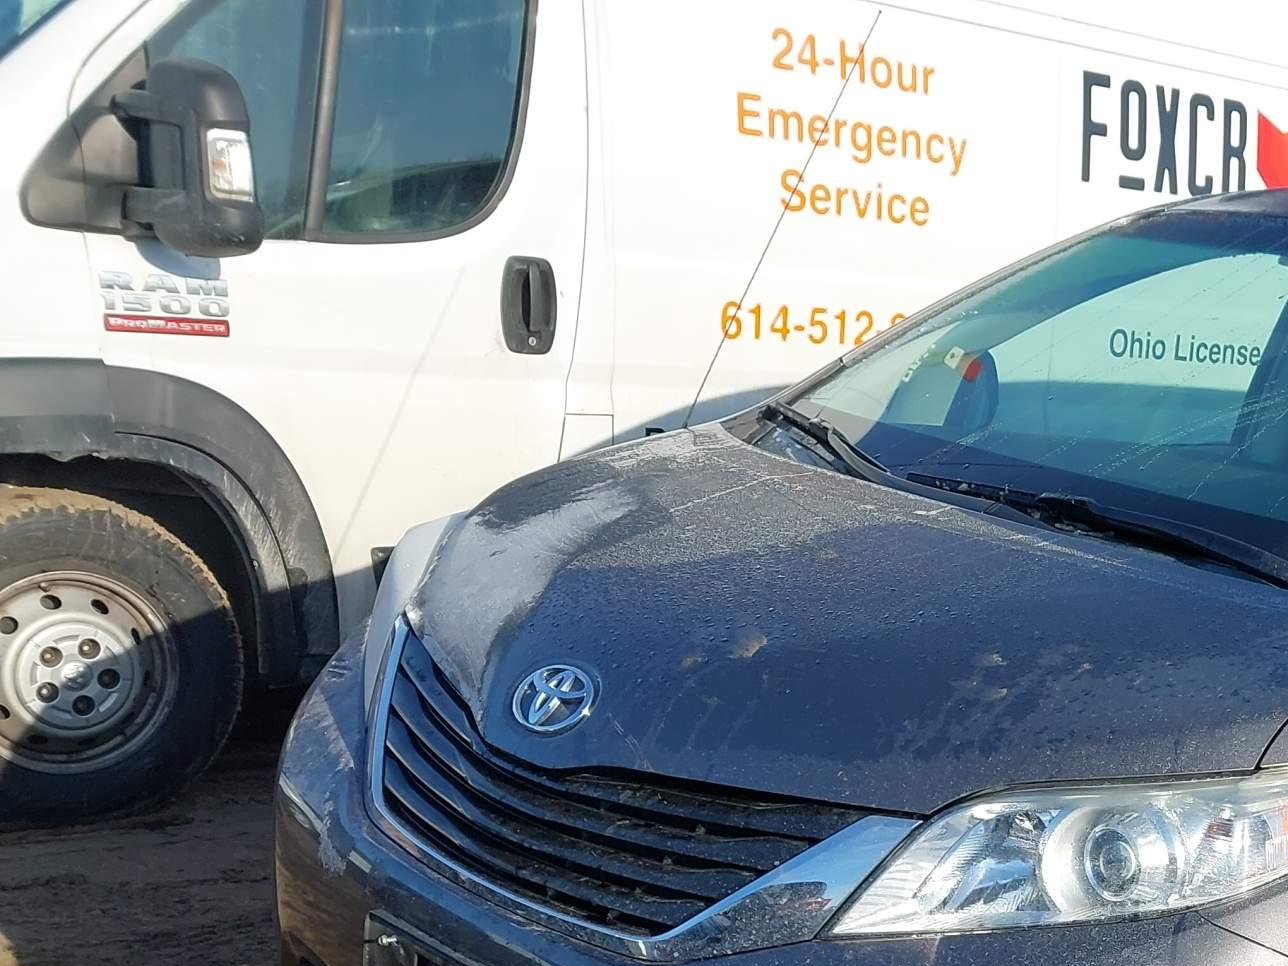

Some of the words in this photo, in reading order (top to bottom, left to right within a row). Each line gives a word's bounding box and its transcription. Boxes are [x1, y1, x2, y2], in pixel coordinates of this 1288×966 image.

[770, 26, 936, 97] 24-Hour
[736, 92, 968, 177] Emergency
[778, 168, 932, 228] Service
[98, 271, 229, 297] RAM
[100, 291, 230, 317] 1500
[1109, 328, 1167, 361] Ohio
[1173, 334, 1263, 367] License
